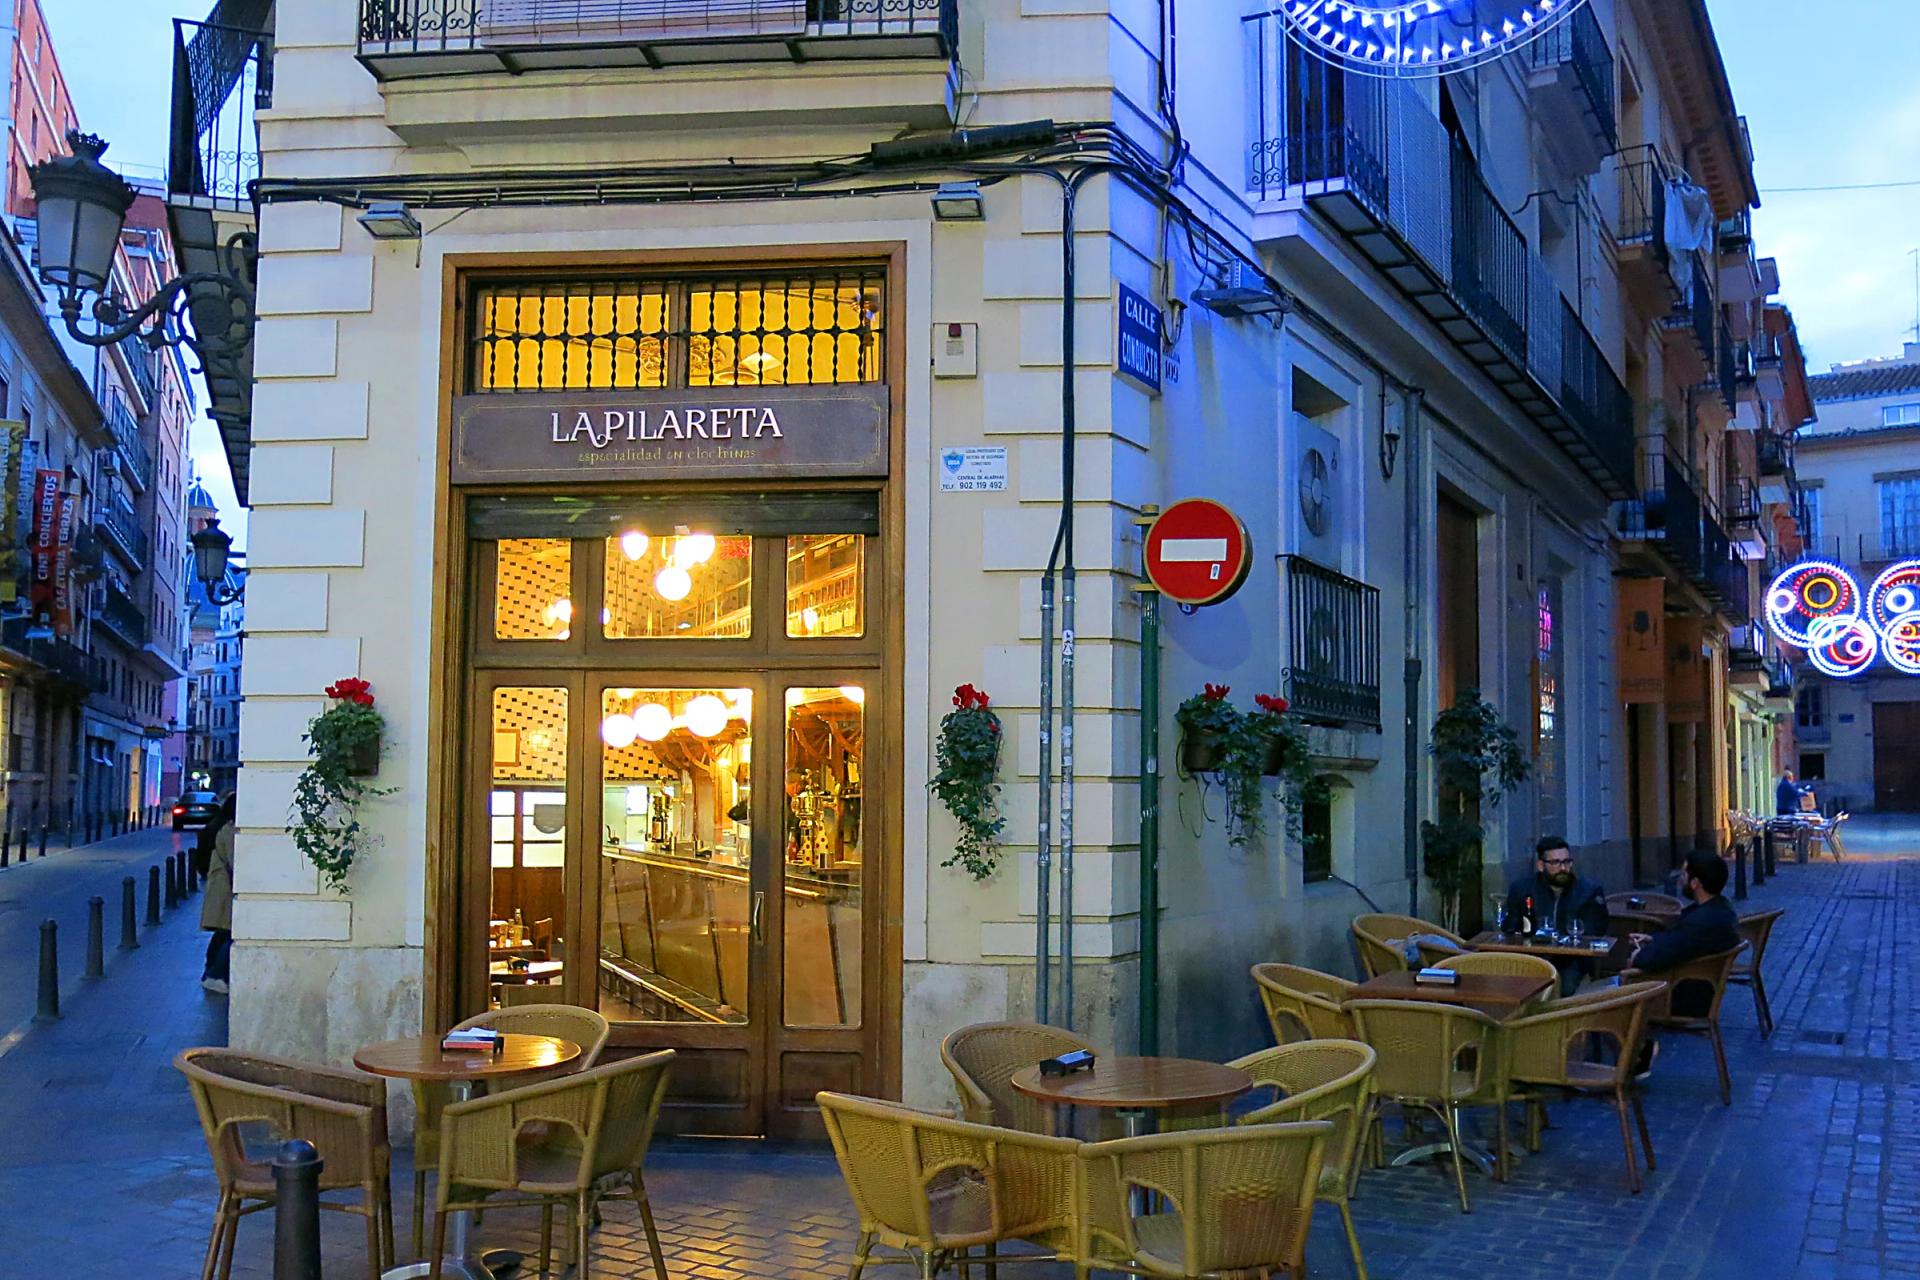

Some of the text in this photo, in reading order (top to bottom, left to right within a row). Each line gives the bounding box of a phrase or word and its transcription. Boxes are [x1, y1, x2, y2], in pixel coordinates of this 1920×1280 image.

[1125, 296, 1156, 333] CALLE
[1122, 332, 1158, 382] CONQUISTA
[579, 447, 661, 465] especialidad
[976, 481, 987, 489] 119
[989, 481, 1003, 489] 492
[38, 475, 57, 580] CINE CONCIERTOS
[58, 498, 74, 547] TERRAZA
